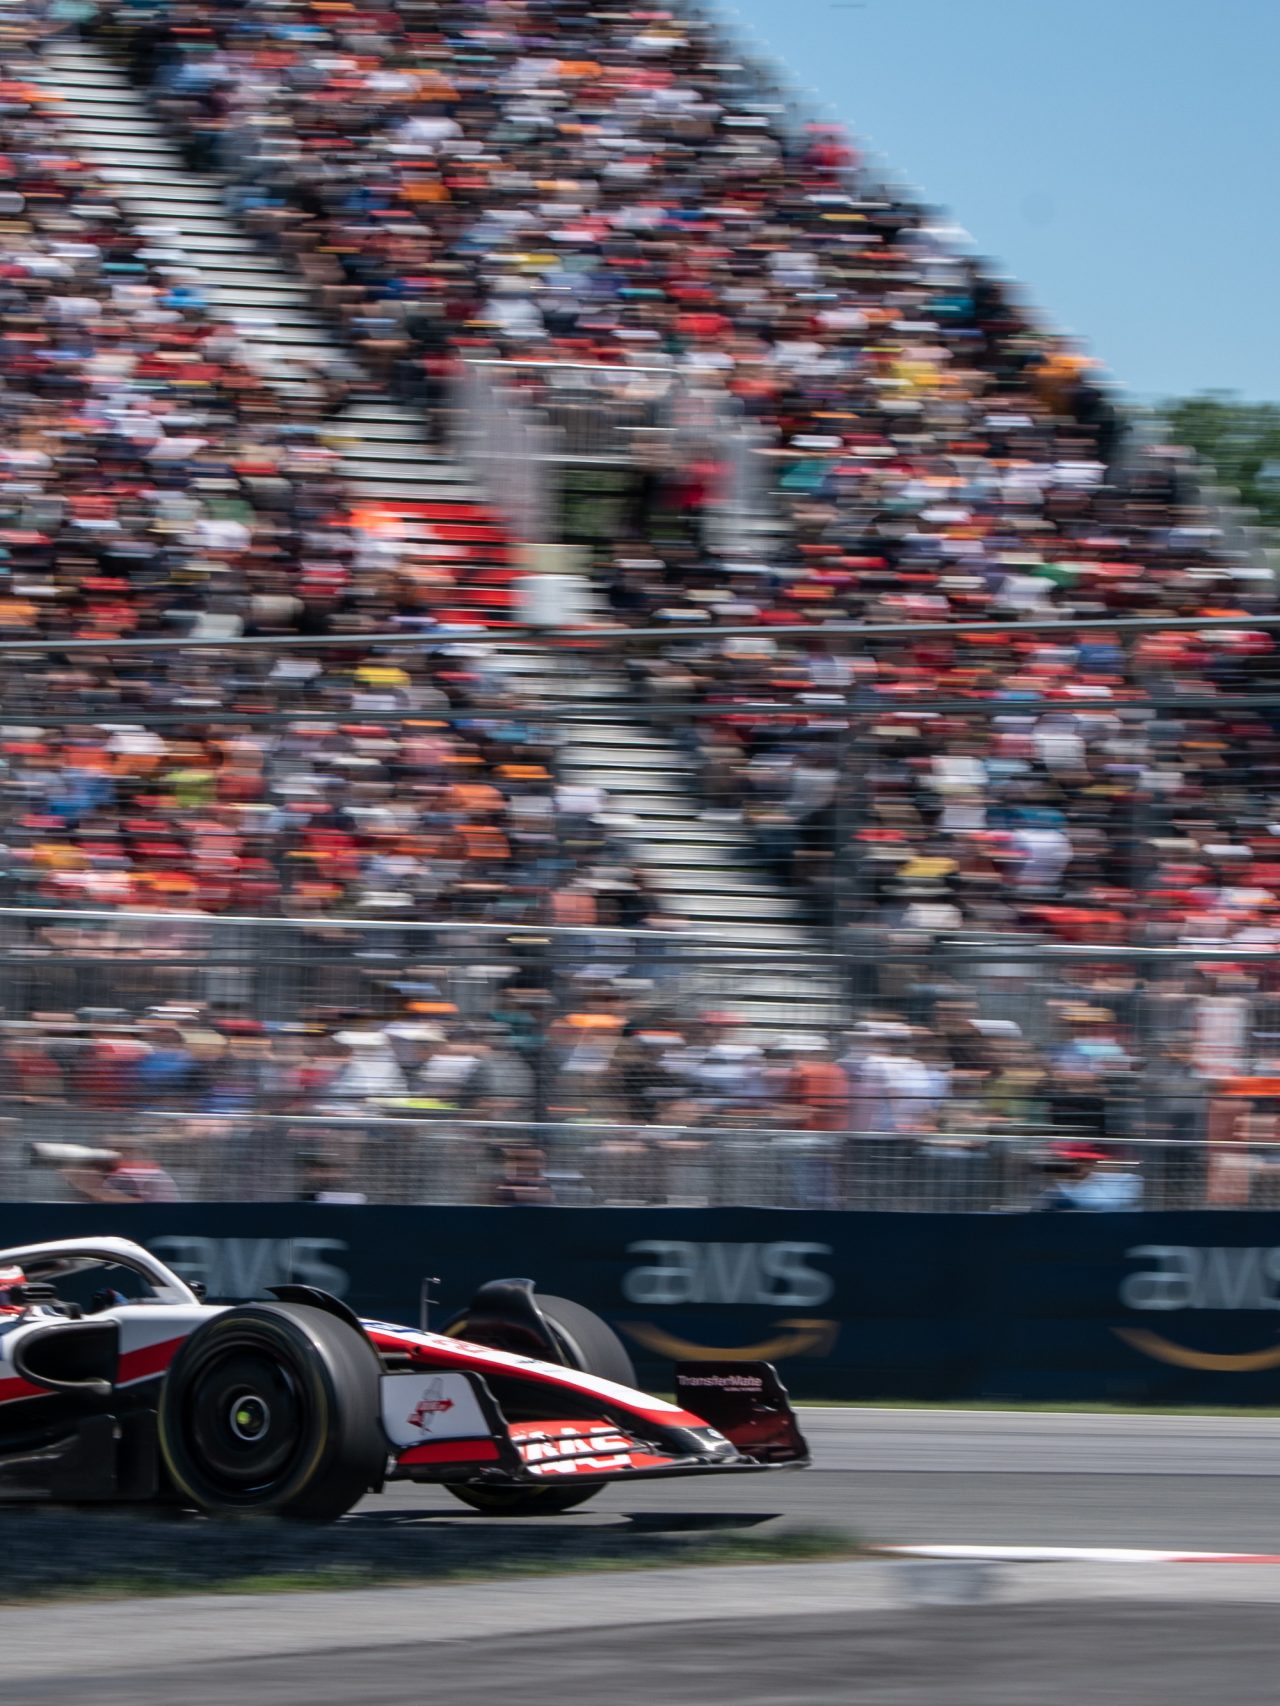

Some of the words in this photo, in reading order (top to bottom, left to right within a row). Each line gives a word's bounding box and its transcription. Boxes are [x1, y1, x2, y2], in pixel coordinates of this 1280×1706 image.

[622, 1240, 834, 1306] aws
[1119, 1245, 1280, 1310] aw
[677, 1374, 763, 1387] TransferMate
